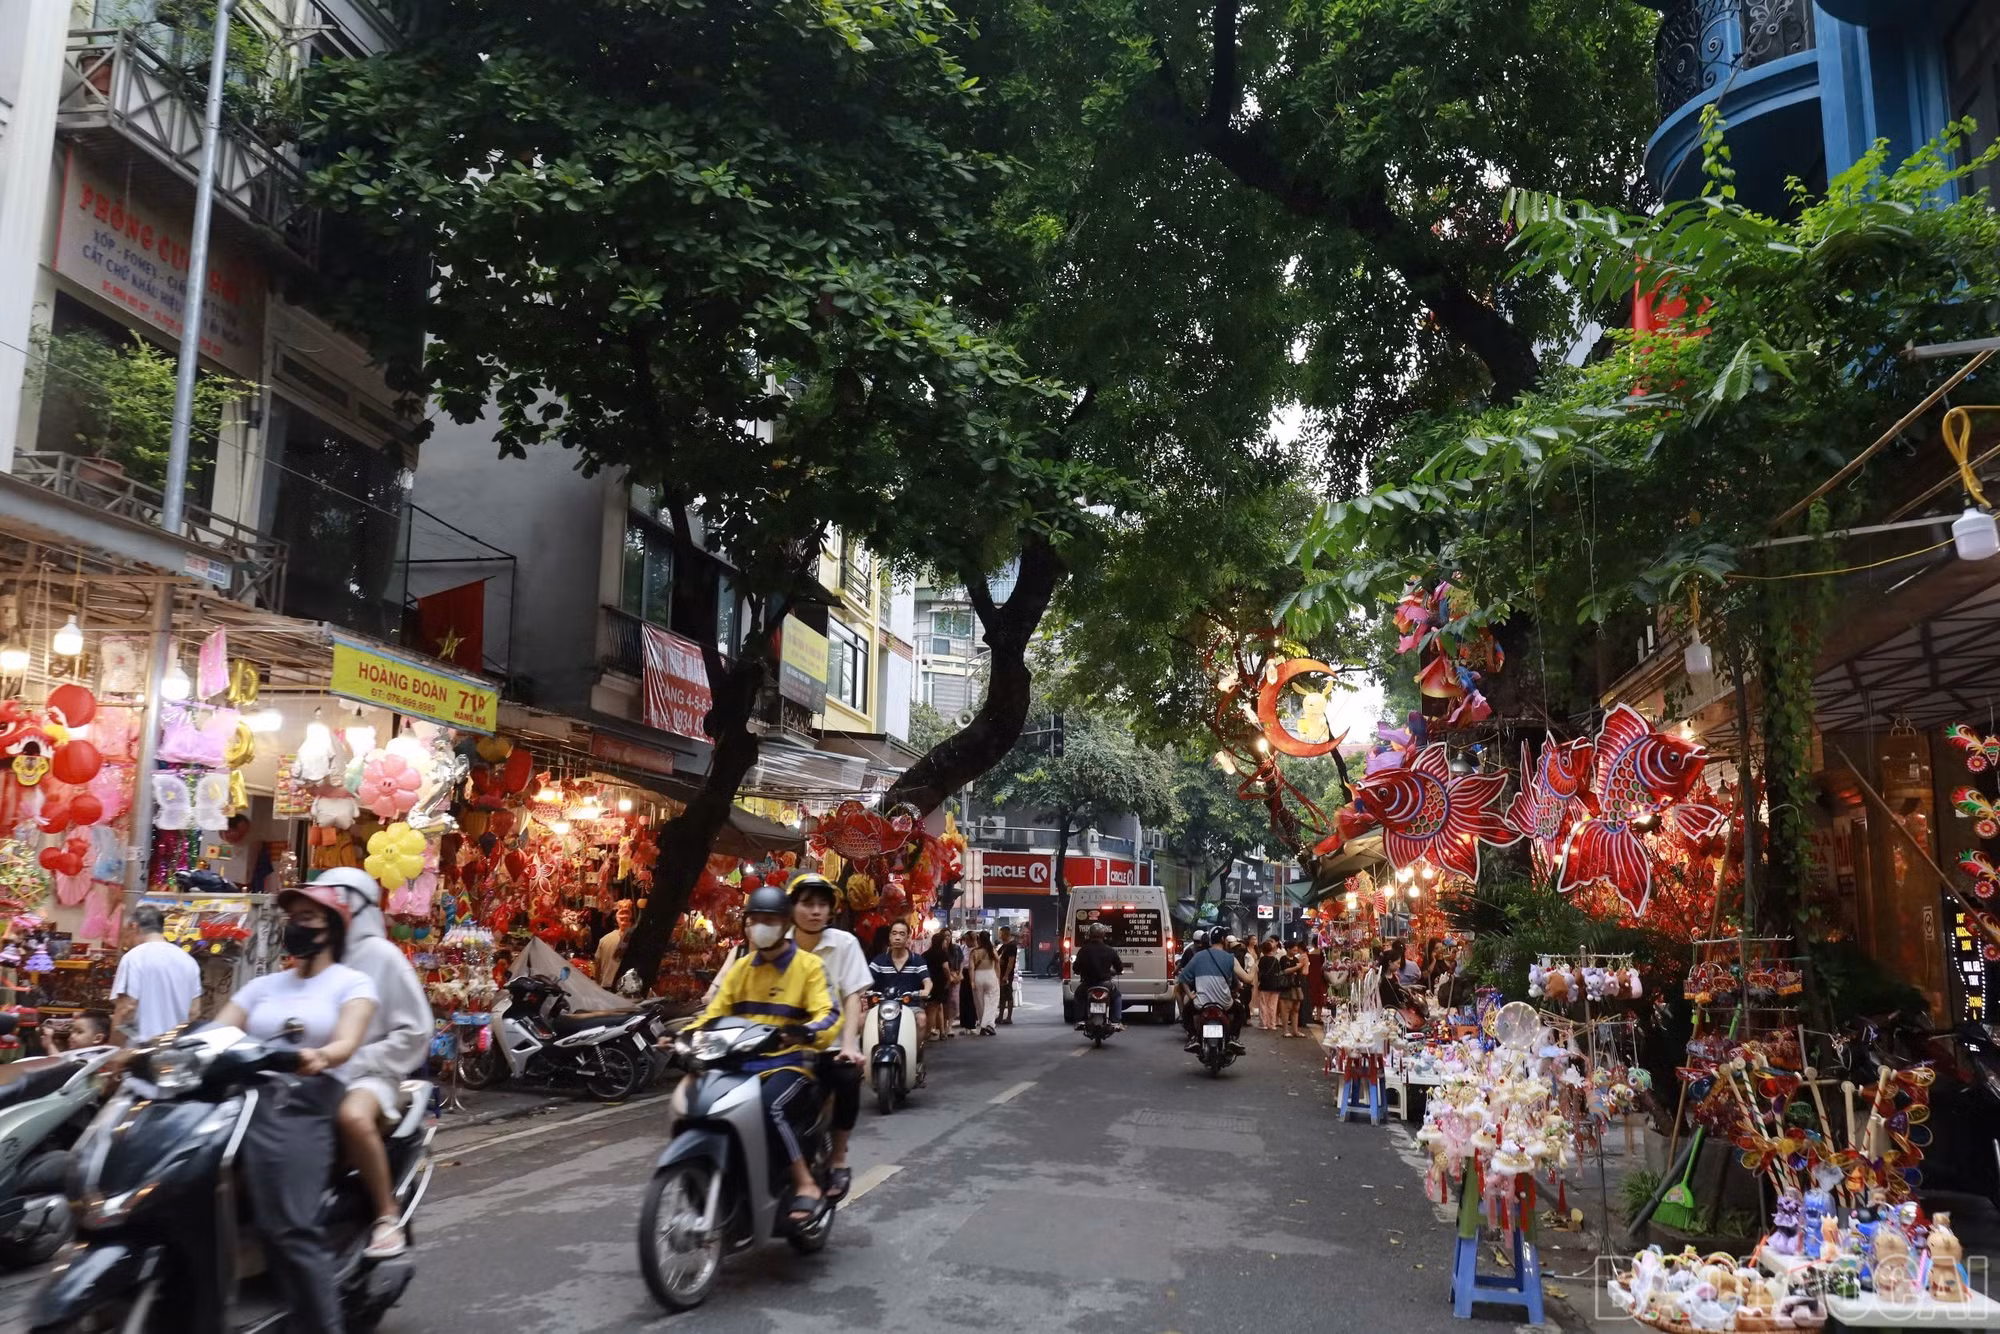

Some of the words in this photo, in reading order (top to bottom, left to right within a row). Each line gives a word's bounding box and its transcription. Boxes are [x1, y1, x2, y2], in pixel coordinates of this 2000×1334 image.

[358, 662, 408, 691] HOÀNG
[412, 678, 448, 703] ĐOÀN
[983, 864, 1026, 878] CIRCLE
[1110, 870, 1127, 884] CIRCLE
